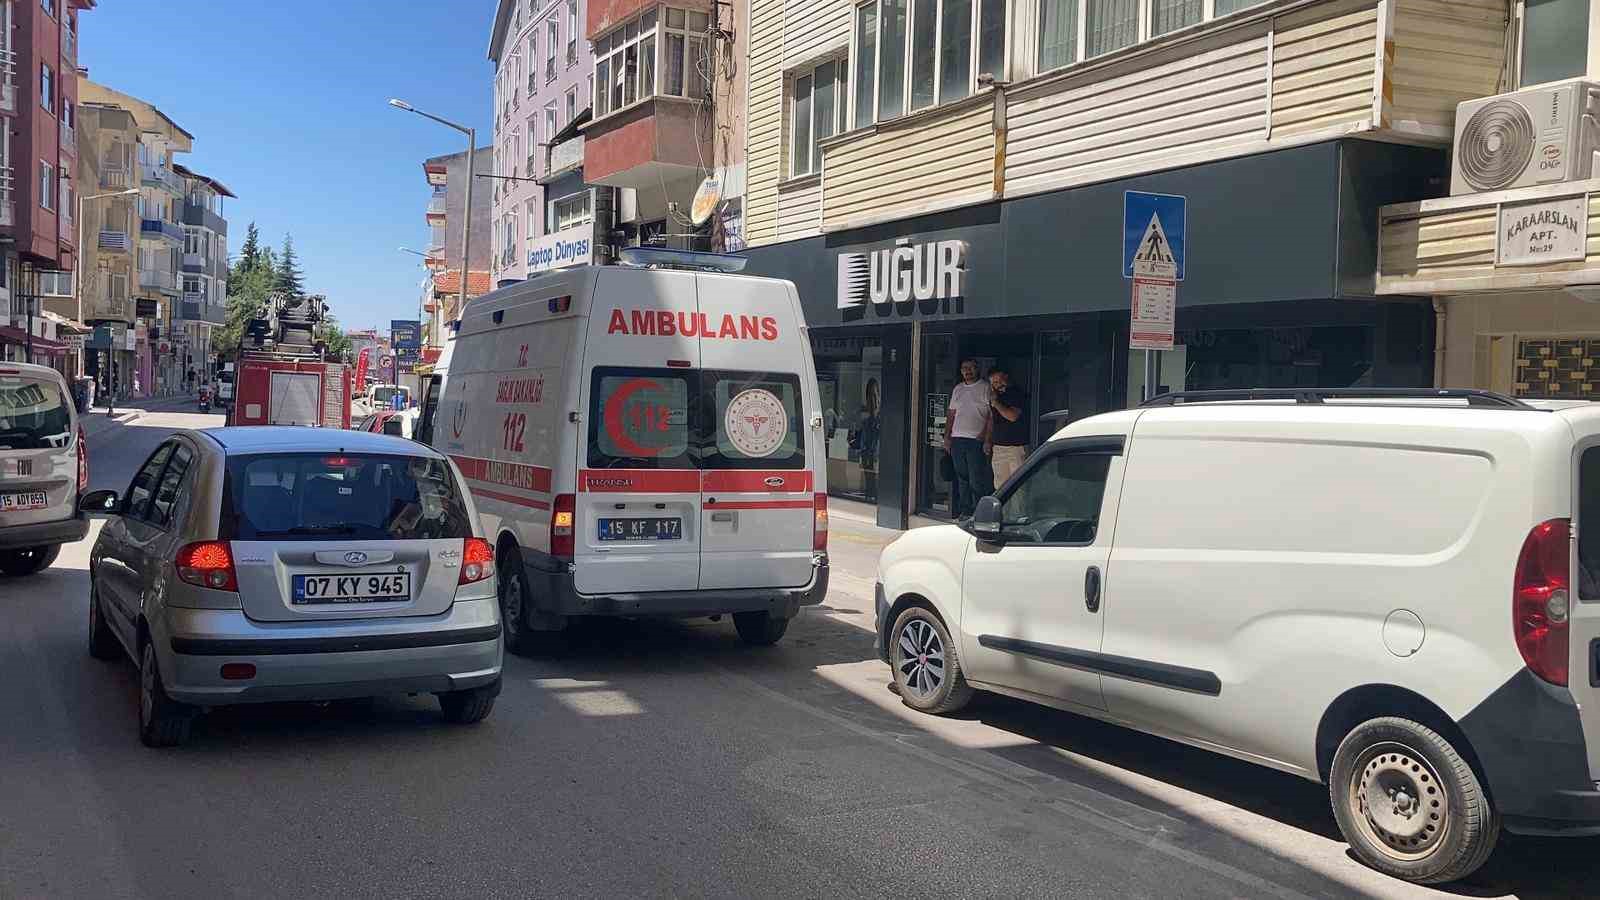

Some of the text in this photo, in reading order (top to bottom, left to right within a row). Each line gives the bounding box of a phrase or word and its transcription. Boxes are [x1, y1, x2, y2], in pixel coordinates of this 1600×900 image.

[1507, 210, 1578, 241] KARAARSLAN
[1530, 230, 1557, 241] APT.
[527, 239, 590, 269] Laptop Dünyası
[870, 238, 961, 304] UĞUR
[607, 309, 779, 341] AMBULANS
[503, 413, 526, 452] 112
[629, 404, 673, 432] 112
[485, 461, 533, 488] AMBULANS
[609, 521, 678, 535] 15 KF 117
[306, 578, 329, 596] 07
[337, 577, 361, 596] KY
[368, 576, 403, 595] 945
